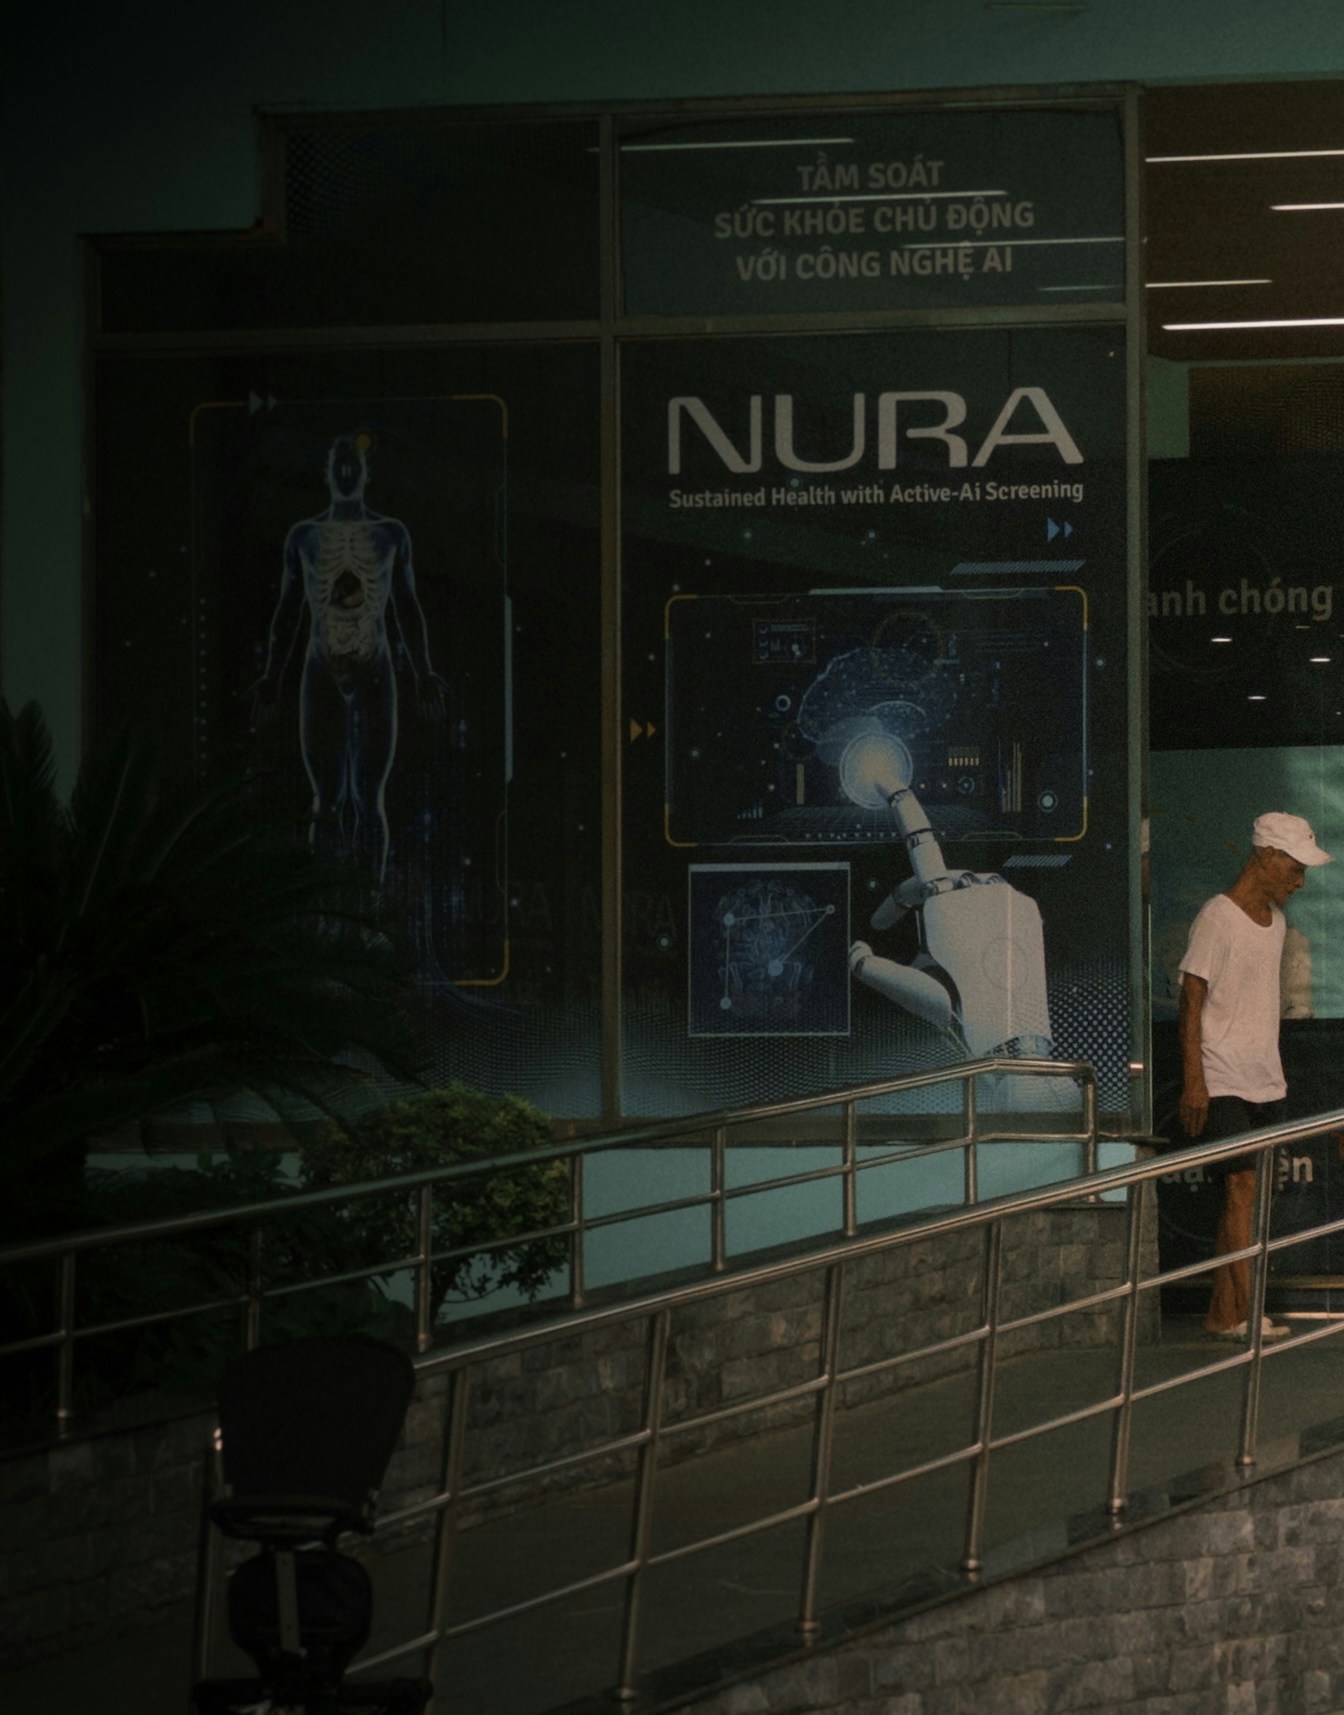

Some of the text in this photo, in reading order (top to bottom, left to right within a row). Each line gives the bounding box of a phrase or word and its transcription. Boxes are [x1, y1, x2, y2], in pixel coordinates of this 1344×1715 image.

[797, 151, 944, 191] TẦM SOÁT
[714, 204, 775, 239] SỨC
[946, 196, 1035, 235] ĐỘNG
[736, 243, 1012, 281] VỚI CÔNG NGHỆ AI
[668, 387, 1085, 475] NURA
[669, 480, 1085, 509] Sustained Health with Active-Ai Screening
[1219, 577, 1333, 622] chóng
